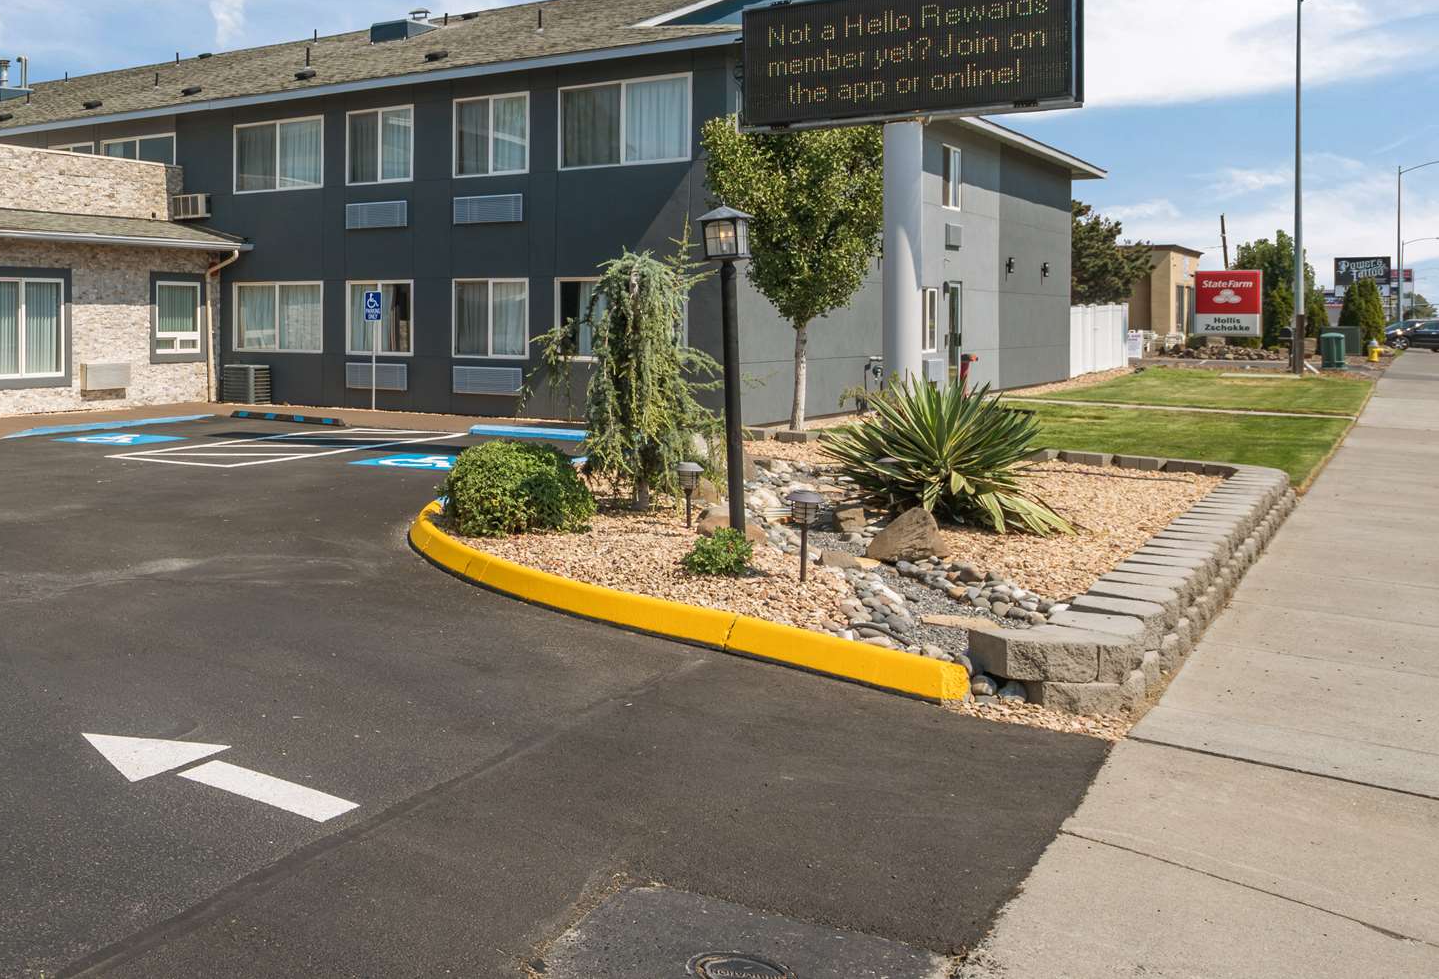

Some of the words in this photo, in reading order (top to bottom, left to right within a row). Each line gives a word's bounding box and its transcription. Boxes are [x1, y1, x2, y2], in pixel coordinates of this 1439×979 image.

[768, 23, 812, 48] Not
[821, 24, 835, 41] a
[845, 10, 911, 39] Hello
[768, 48, 866, 78] member
[873, 37, 932, 70] yet?
[939, 31, 1000, 59] Join
[1010, 28, 1049, 51] on
[788, 82, 828, 108] the
[837, 79, 886, 104] app
[895, 75, 920, 94] or
[930, 58, 1022, 91] online!
[1204, 323, 1250, 332] Zschokke
[1213, 316, 1241, 324] Hollis
